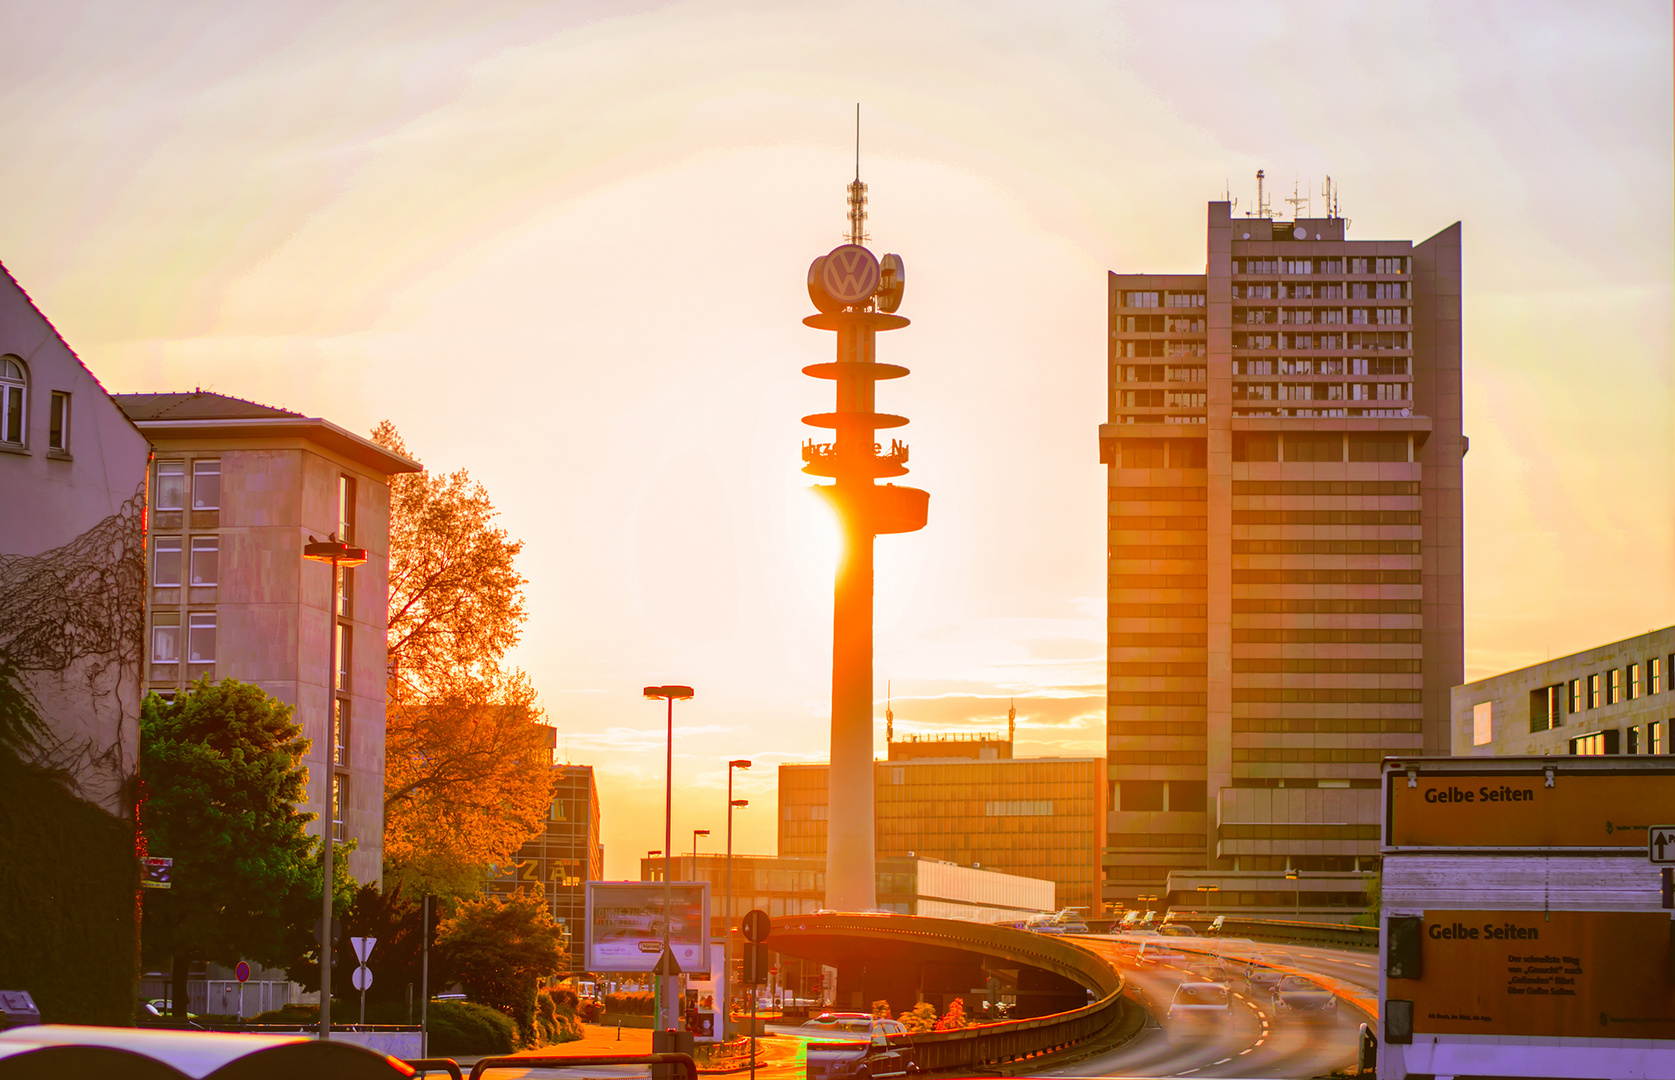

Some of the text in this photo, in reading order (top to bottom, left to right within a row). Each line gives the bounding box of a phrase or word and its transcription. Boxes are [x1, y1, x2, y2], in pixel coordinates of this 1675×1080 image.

[826, 249, 873, 298] VW
[1424, 785, 1534, 803] Gelbe Seiten
[1428, 923, 1539, 940] Gelbe Seiten
[1523, 955, 1561, 963] schnellste
[1562, 956, 1580, 965] Weg
[1527, 987, 1549, 995] Gelbe
